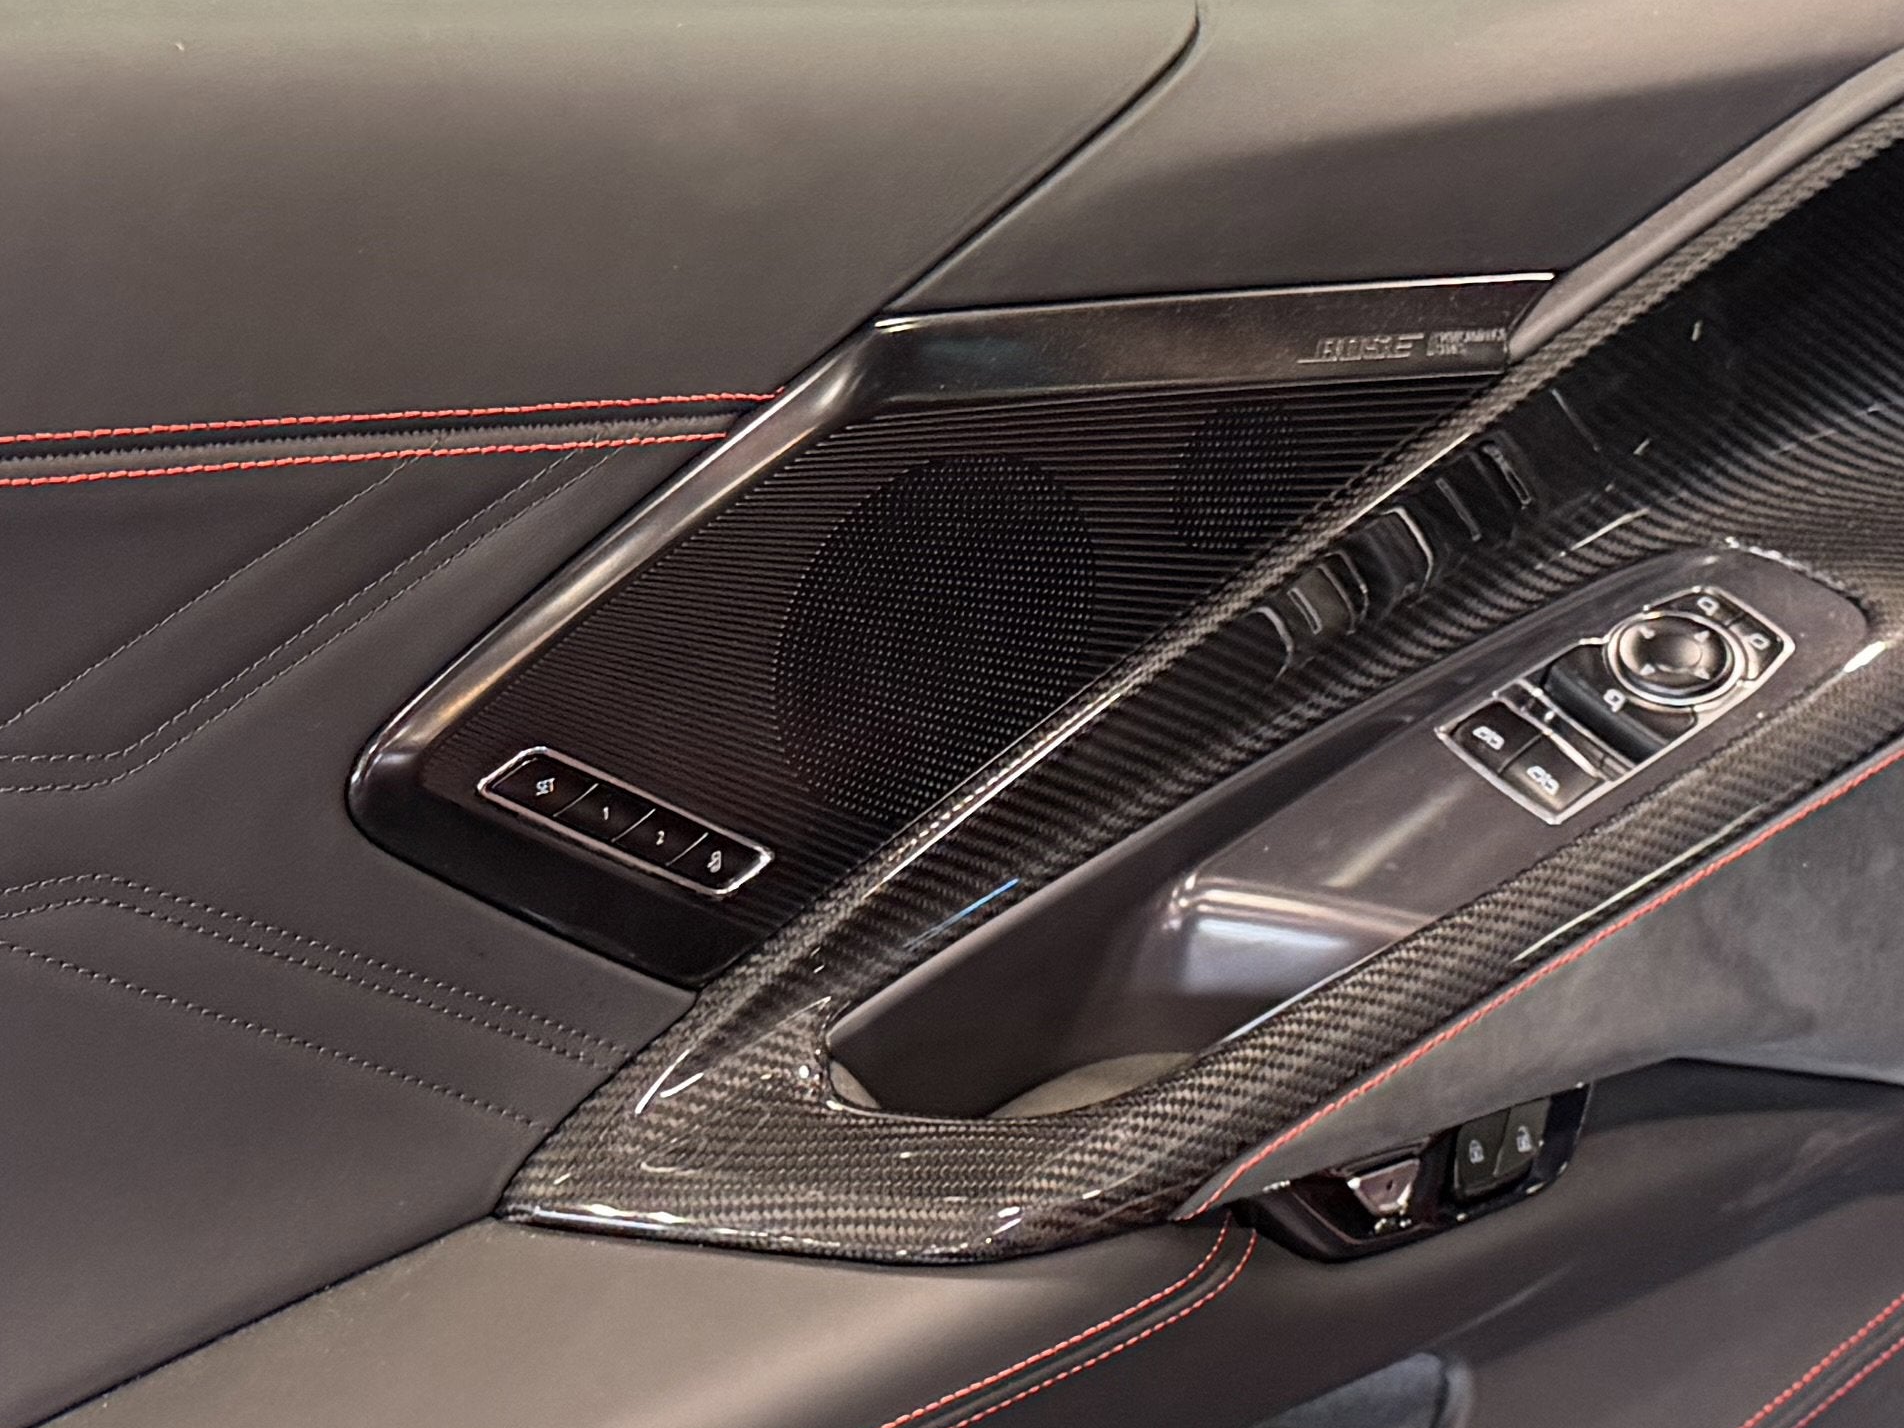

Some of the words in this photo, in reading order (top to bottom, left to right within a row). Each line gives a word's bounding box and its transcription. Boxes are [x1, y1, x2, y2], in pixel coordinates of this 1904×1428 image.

[1296, 333, 1424, 364] BOSE
[602, 805, 610, 822] 1
[655, 829, 666, 846] 2
